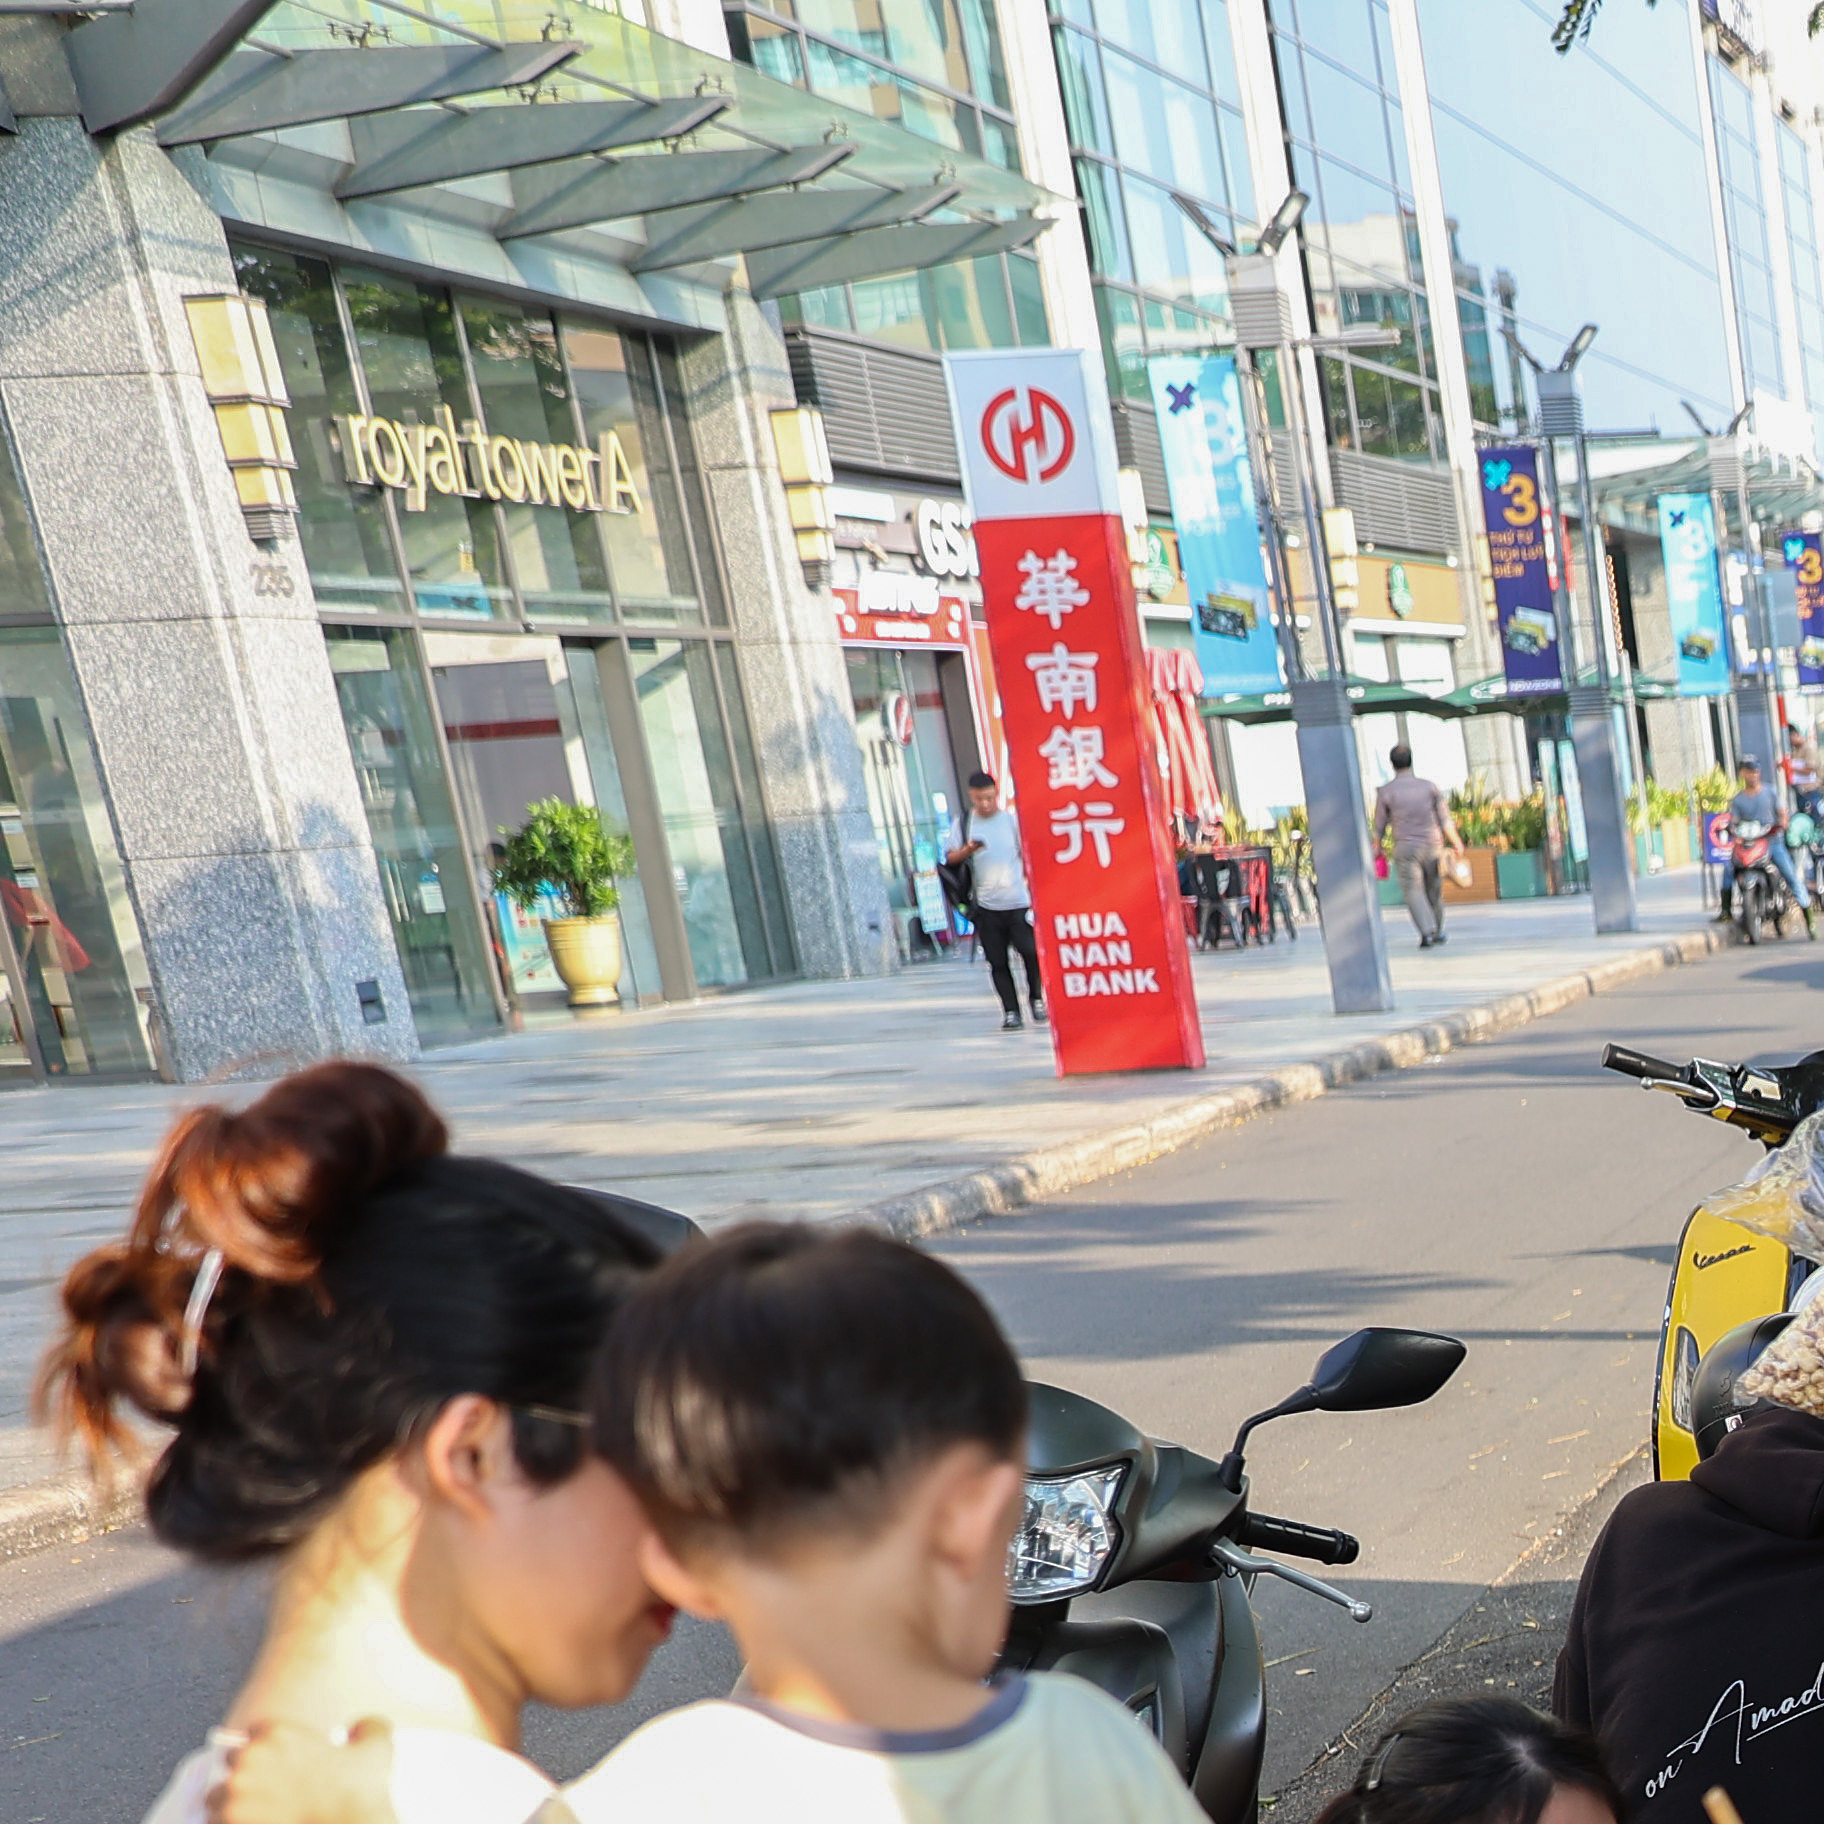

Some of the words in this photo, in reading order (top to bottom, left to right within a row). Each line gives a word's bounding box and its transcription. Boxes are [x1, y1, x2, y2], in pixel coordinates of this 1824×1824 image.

[348, 403, 467, 512] royal
[472, 420, 596, 510] tower
[602, 430, 643, 514] A
[1015, 548, 1126, 869] 華南銀行
[1054, 911, 1128, 940] HUA
[1059, 940, 1132, 969] NAN
[1063, 968, 1160, 998] BANK
[1645, 1759, 1683, 1798] on
